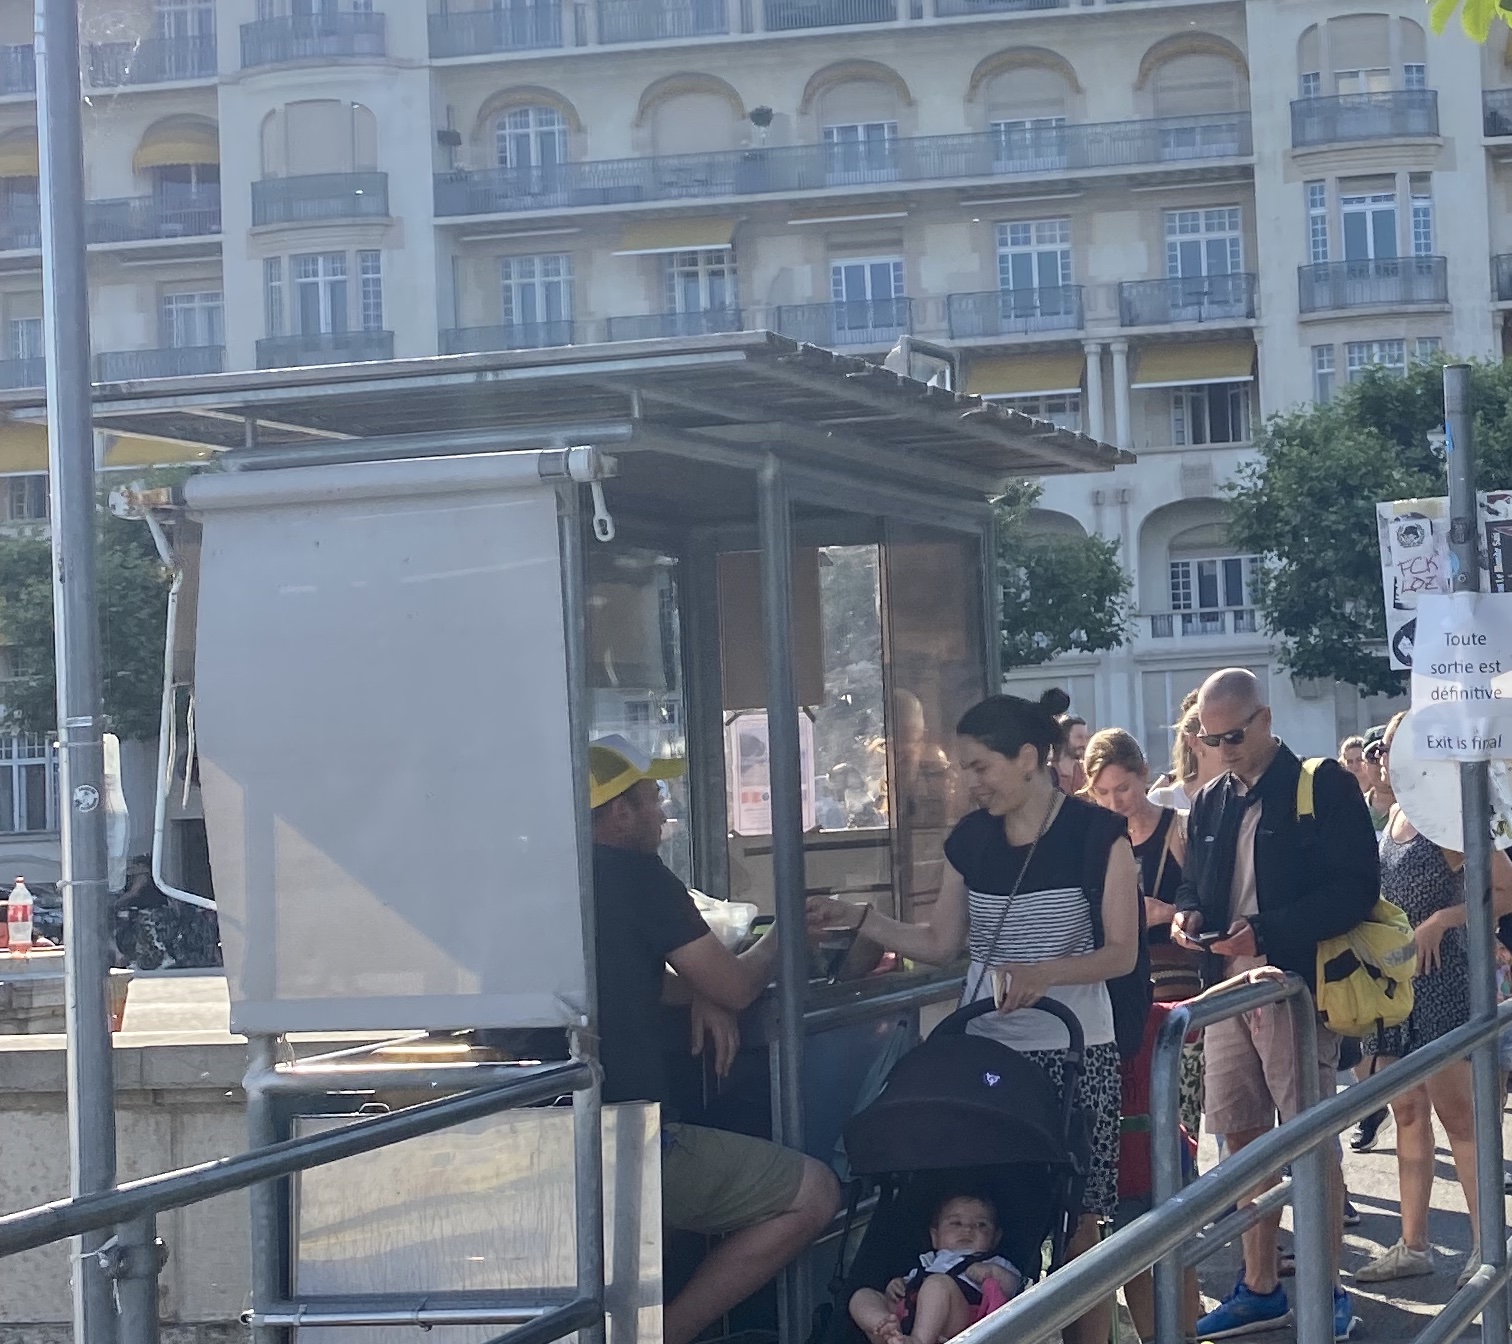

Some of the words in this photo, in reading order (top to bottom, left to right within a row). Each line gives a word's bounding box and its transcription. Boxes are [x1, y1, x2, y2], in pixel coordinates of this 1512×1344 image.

[1444, 632, 1487, 646] Toute
[1430, 661, 1474, 675] sortie
[1479, 660, 1502, 674] est
[1431, 685, 1502, 701] définitive
[1427, 735, 1452, 749] Exit
[1456, 736, 1467, 749] is
[1472, 734, 1502, 750] final
